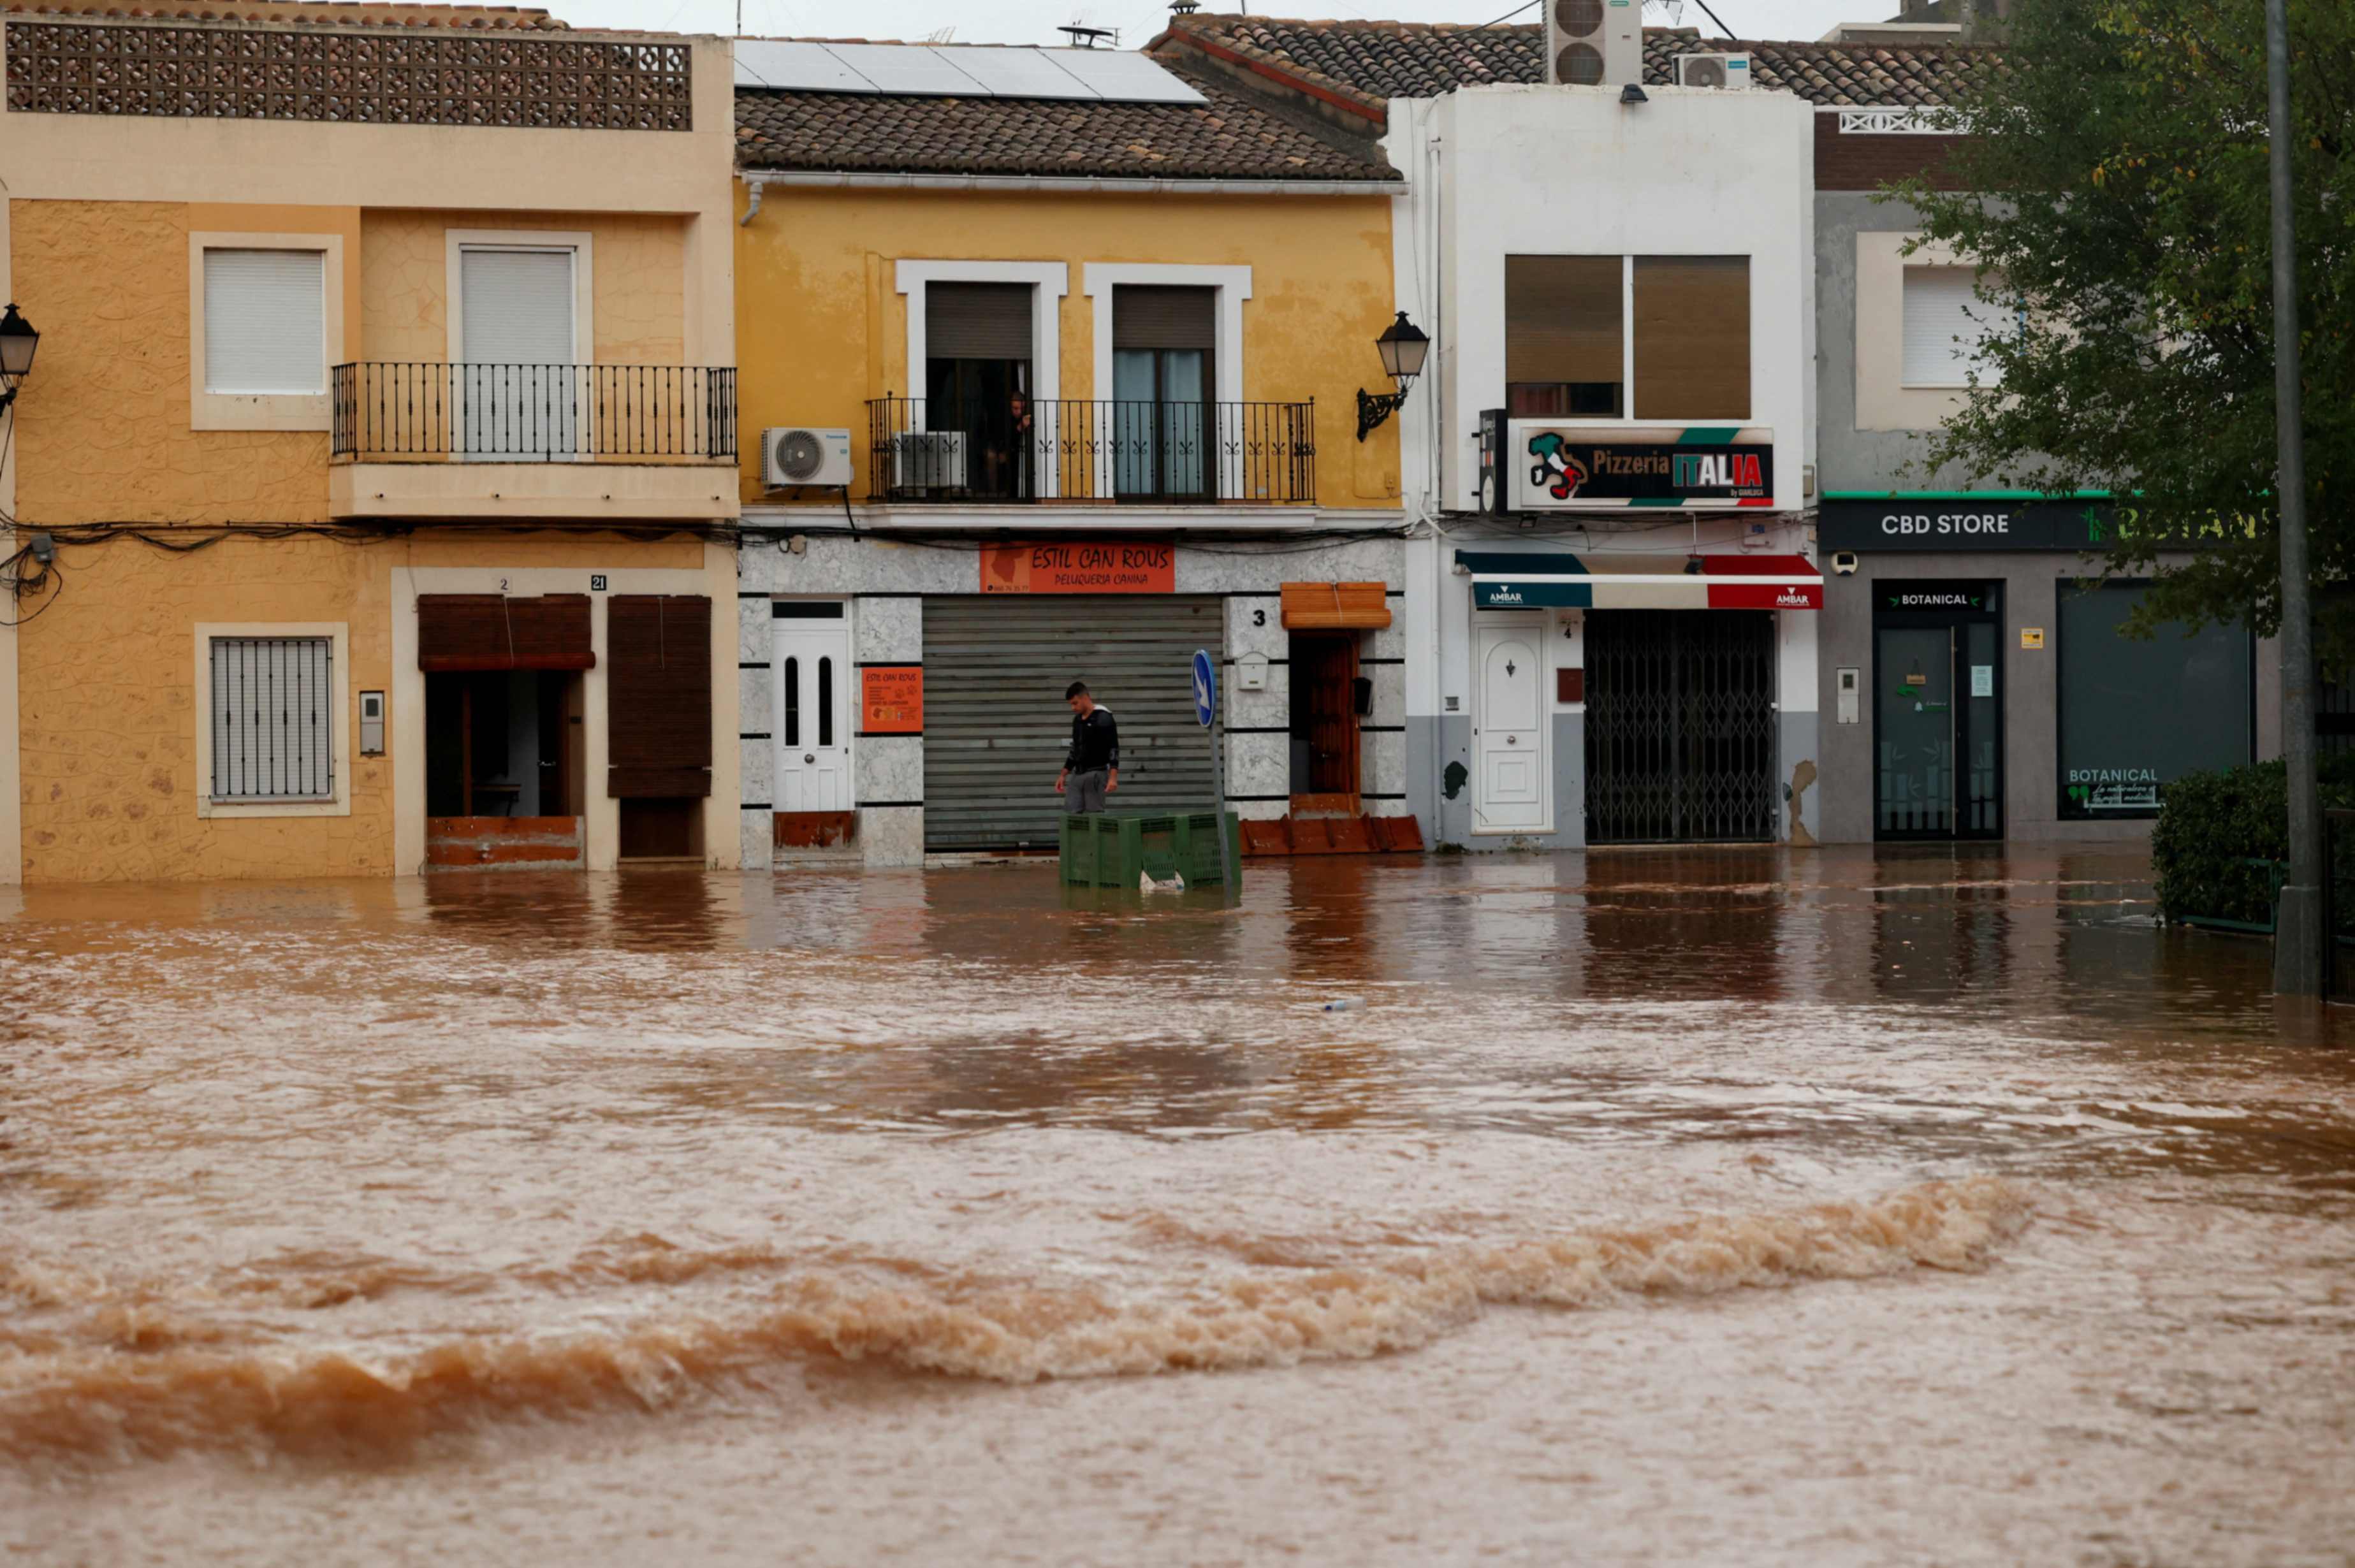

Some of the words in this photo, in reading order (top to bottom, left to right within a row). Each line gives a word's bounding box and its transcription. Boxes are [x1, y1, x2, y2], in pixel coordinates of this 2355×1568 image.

[1593, 449, 1670, 475] Pizzeria
[1672, 453, 1762, 487] ITALIA
[1881, 515, 1930, 535] CBD
[1937, 514, 2009, 534] STORE
[1032, 548, 1072, 569] ESTIL
[1078, 548, 1116, 569] CAN
[1122, 549, 1169, 569] ROUS
[592, 576, 605, 589] 21
[1055, 574, 1111, 585] PELUQUERIA
[1114, 574, 1148, 584] CANINA
[1490, 593, 1522, 601] AMBAR
[1776, 595, 1809, 603] AMBAR
[1902, 594, 1968, 605] BOTANICAL
[1253, 610, 1266, 627] 3
[1564, 628, 1571, 638] 4
[2069, 769, 2157, 782] BOTANICAL
